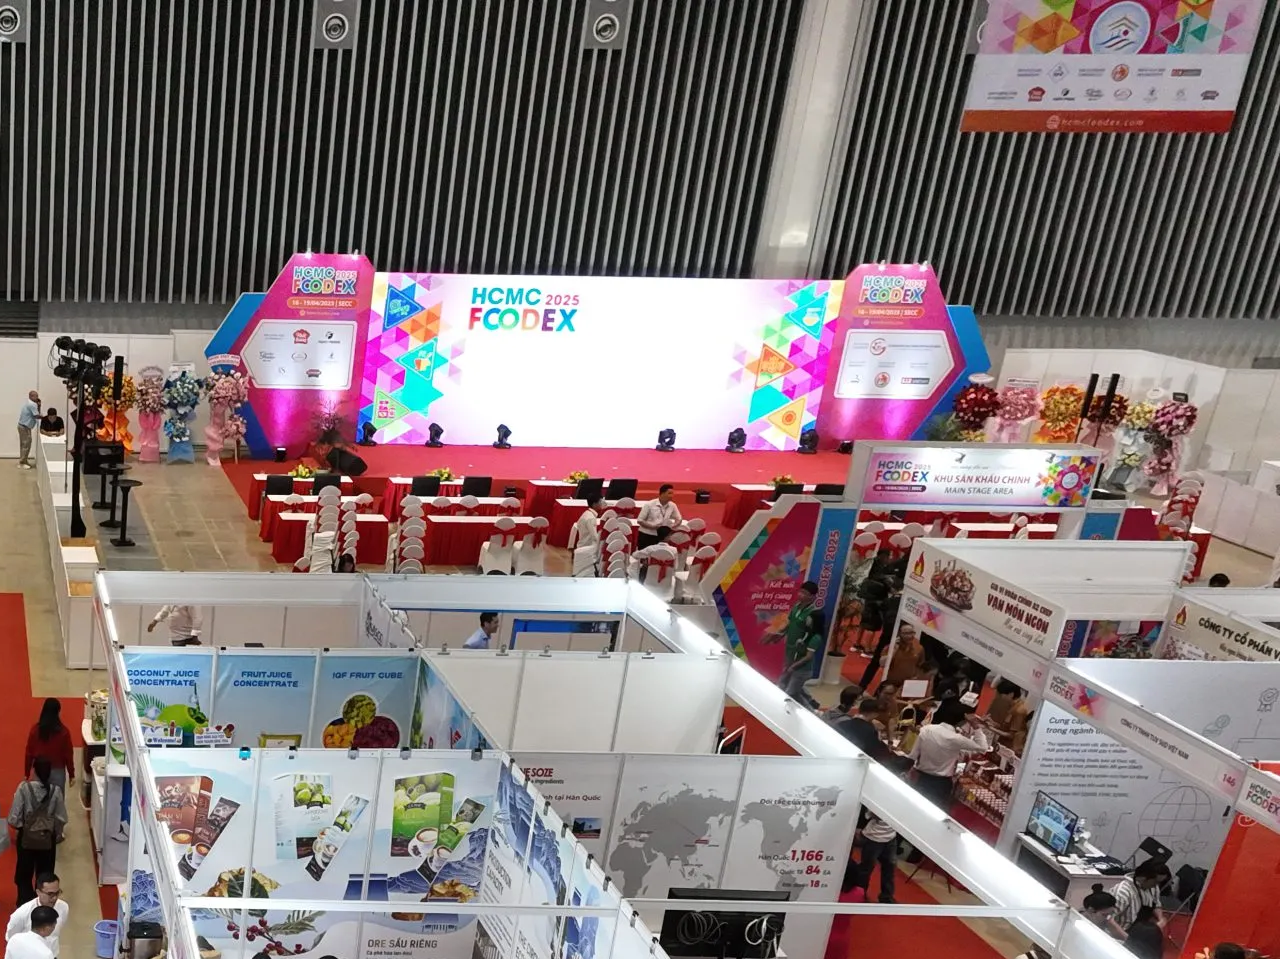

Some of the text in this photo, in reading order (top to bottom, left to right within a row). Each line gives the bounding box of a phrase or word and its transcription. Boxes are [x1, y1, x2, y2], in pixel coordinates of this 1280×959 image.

[294, 267, 357, 279] HCMC 2025
[863, 276, 905, 287] HCMC
[472, 288, 580, 305] HCMC 2025
[878, 460, 912, 470] HCMC
[934, 475, 953, 484] KHU
[944, 487, 1014, 496] MAIN STAGE AREA
[825, 530, 841, 561] 2025
[815, 563, 833, 609] OODEX
[987, 593, 1004, 612] VẠN
[1004, 602, 1023, 622] MÓN
[1024, 612, 1050, 634] NGON
[1198, 617, 1222, 634] CÔNG
[1222, 627, 1234, 640] TY
[1234, 631, 1249, 645] CỔ
[127, 670, 200, 678] COCONUT JUICE
[332, 672, 403, 680] IQF FRUIT CUBE
[129, 679, 195, 687] CONCENTRATE
[233, 680, 299, 688] CONCENTRATE
[1048, 716, 1070, 726] Cung
[1046, 727, 1094, 735] trong ngành
[531, 767, 554, 778] SOZE
[1222, 773, 1237, 788] 146
[1249, 782, 1273, 800] HCMC
[791, 849, 824, 862] 1,166
[805, 865, 821, 875] 84
[809, 880, 820, 888] 18
